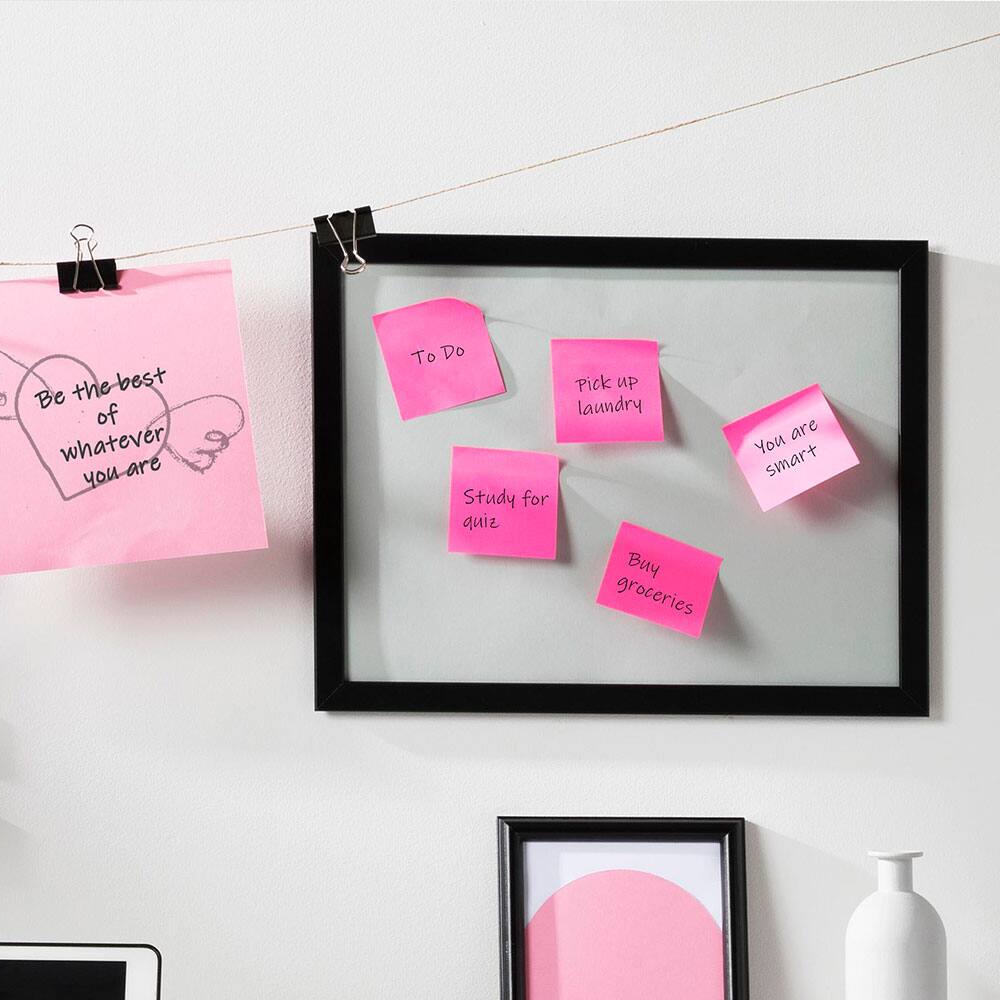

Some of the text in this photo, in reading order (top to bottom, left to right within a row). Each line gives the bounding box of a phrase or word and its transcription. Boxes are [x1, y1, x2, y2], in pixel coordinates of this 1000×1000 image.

[411, 344, 466, 365] To Do
[34, 367, 166, 409] Be the best
[575, 374, 639, 394] Pick up
[97, 402, 119, 425] of
[578, 395, 643, 416] laundry
[60, 429, 164, 462] whatever
[754, 416, 819, 455] You are
[84, 456, 162, 489] you are
[765, 444, 817, 477] smart
[463, 488, 549, 509] Study for
[463, 512, 500, 530] quiz
[628, 552, 661, 579] Buy
[617, 576, 694, 616] groceries
